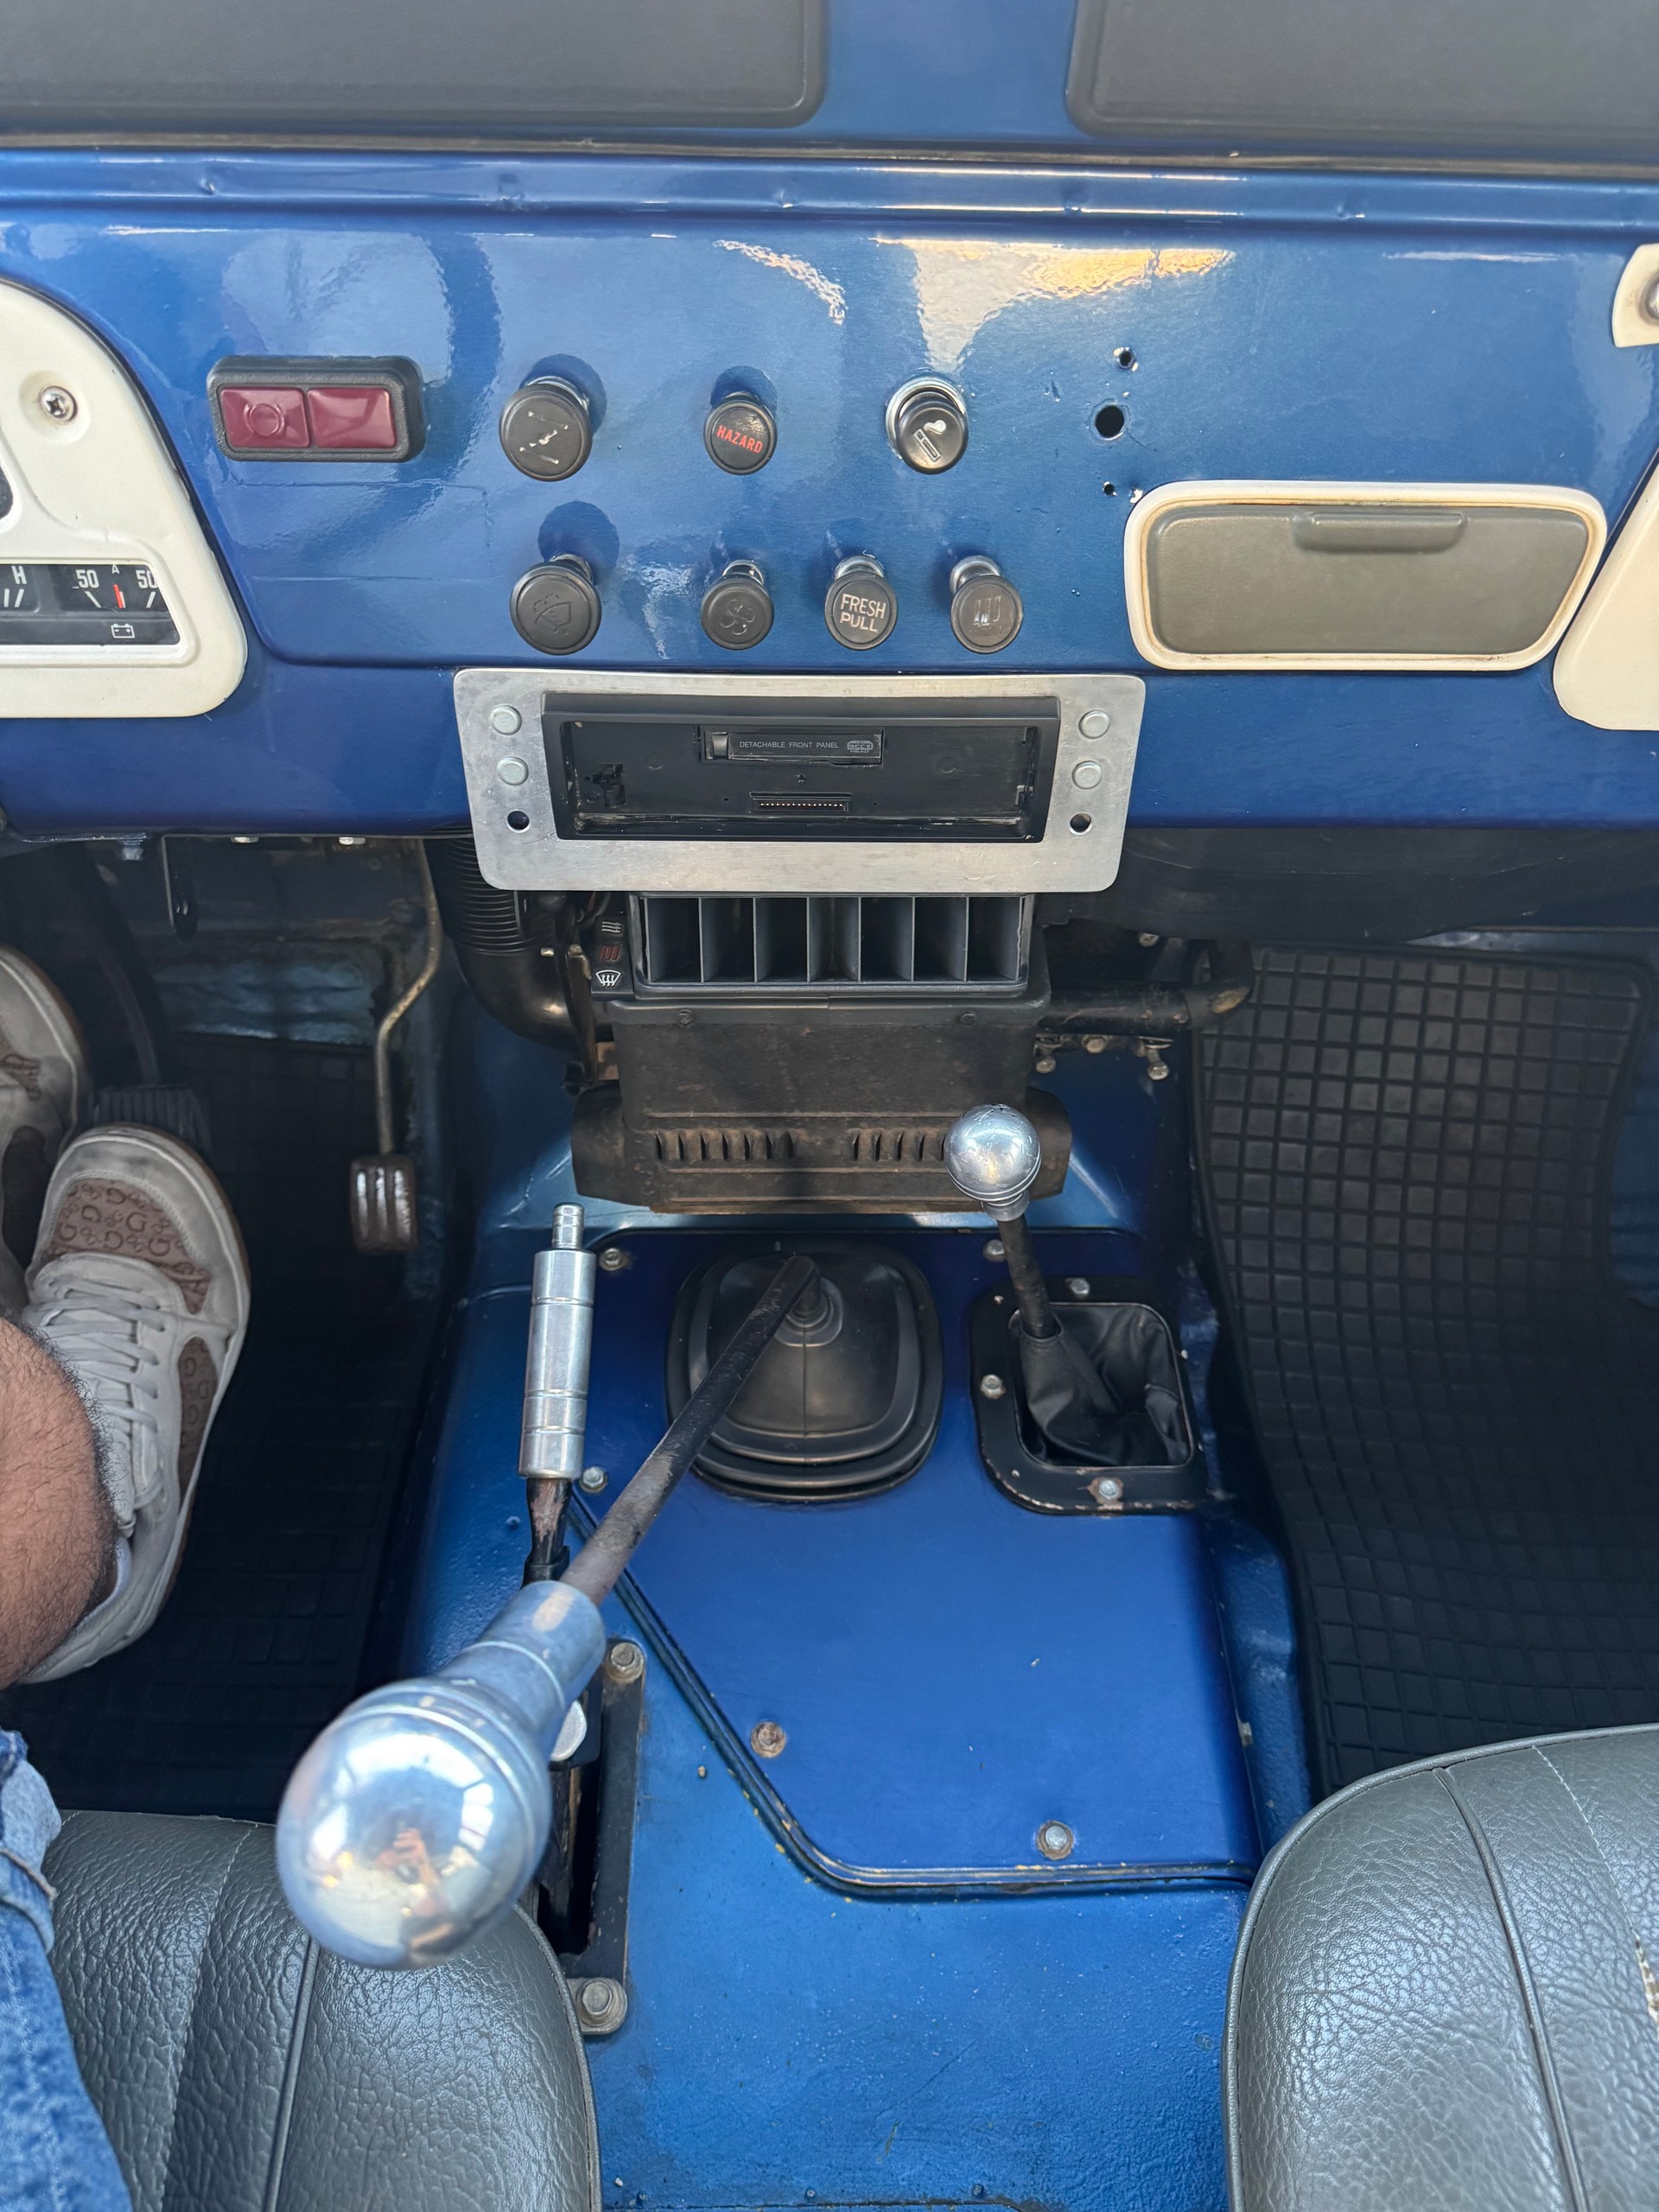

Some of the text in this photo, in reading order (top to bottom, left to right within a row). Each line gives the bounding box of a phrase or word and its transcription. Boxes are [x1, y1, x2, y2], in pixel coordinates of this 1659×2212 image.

[716, 424, 763, 454] HAZARD
[11, 565, 28, 585] H
[840, 593, 887, 620] FRESH
[839, 612, 879, 633] PULL
